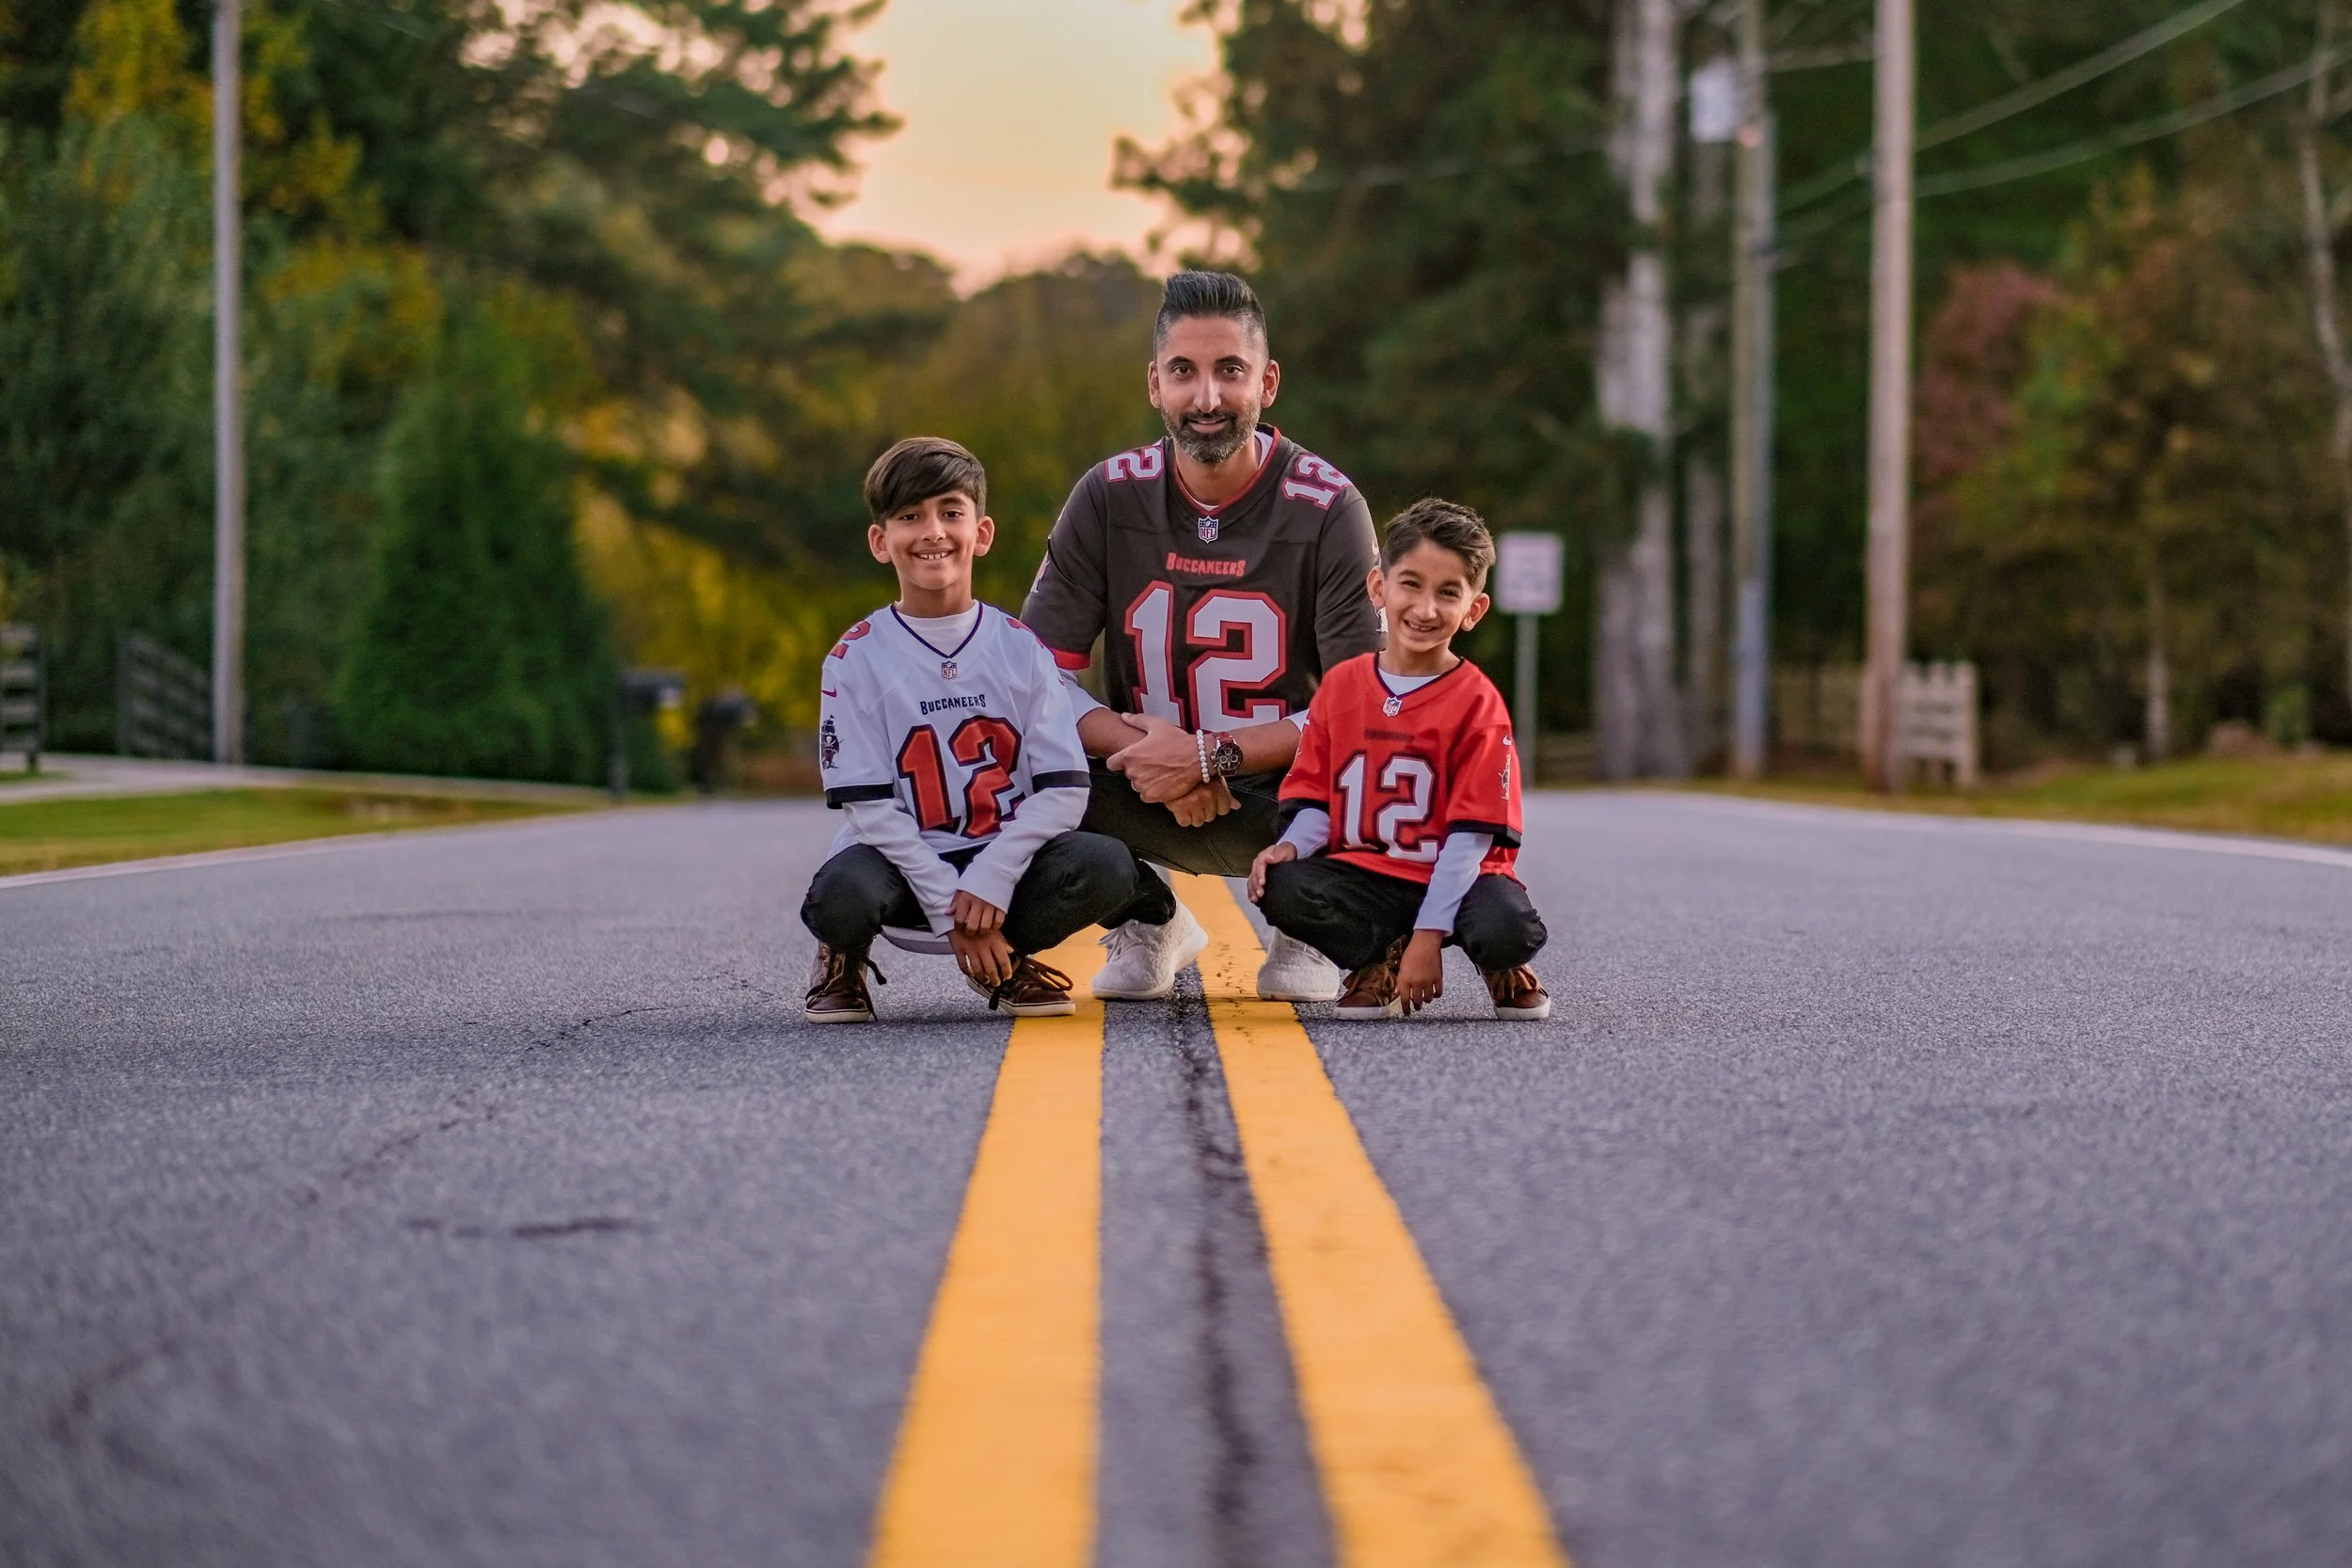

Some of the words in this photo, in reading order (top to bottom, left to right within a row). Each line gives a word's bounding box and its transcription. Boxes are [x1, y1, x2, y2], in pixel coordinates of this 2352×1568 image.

[1281, 454, 1352, 510] 12
[1166, 552, 1246, 577] BUCCANEERS
[1125, 580, 1286, 732] 12
[920, 694, 986, 715] BUCCANEERS
[896, 715, 1025, 838] 12
[1334, 751, 1440, 863] 12
